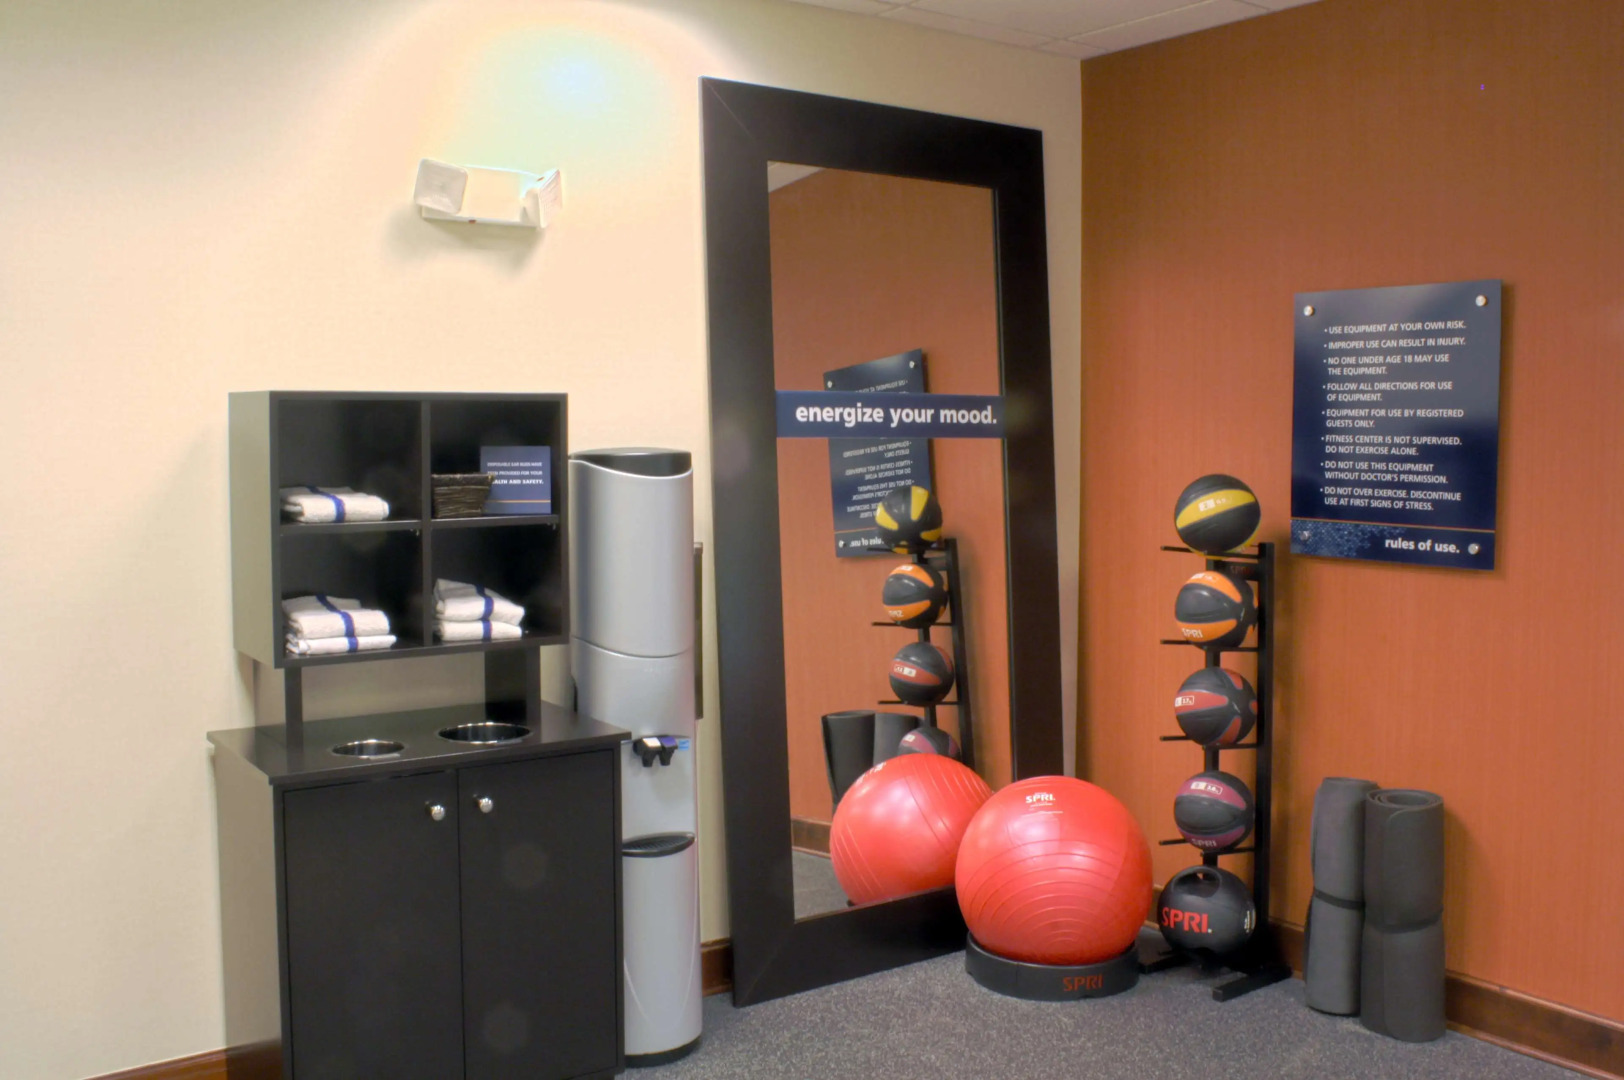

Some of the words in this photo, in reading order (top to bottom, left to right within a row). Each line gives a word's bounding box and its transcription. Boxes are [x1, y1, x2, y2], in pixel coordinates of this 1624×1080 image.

[1329, 326, 1342, 334] USE
[1344, 324, 1387, 333] EQUIPMENT
[1400, 323, 1422, 331] YOUR
[1424, 322, 1445, 330] OWN
[1447, 320, 1466, 329] RISK.
[1329, 341, 1364, 349] IMPROPER
[1366, 340, 1379, 348] USE
[1381, 340, 1397, 348] CAN
[1399, 338, 1425, 347] RESULT
[1427, 338, 1435, 346] IN
[1437, 337, 1466, 346] INJURY.
[1358, 356, 1384, 364] UNDER
[1404, 355, 1412, 363] 18
[1414, 355, 1433, 363] MAY
[1435, 354, 1449, 362] USE
[1344, 367, 1388, 375] EQUIPMENT.
[1374, 382, 1418, 390] DIRECTIONS
[1420, 382, 1436, 390] FOR
[1338, 394, 1382, 402] EQUIPMENT.
[796, 402, 884, 427] energize
[889, 407, 935, 428] your
[940, 405, 997, 424] mood.
[1326, 409, 1369, 418] EQUIPMENT
[1371, 409, 1386, 417] FOR
[1388, 409, 1402, 417] USE
[1404, 409, 1415, 417] BY
[1417, 409, 1463, 417] REGISTERED
[1326, 435, 1353, 443] FITNESS
[1355, 436, 1383, 444] CENTER
[1385, 436, 1392, 444] IS
[1394, 436, 1410, 444] NOT
[1412, 437, 1462, 445] SUPERVISED.
[1338, 446, 1354, 454] NOT
[1356, 446, 1388, 455] EXERCISE
[1391, 447, 1419, 455] ALONE.
[1338, 461, 1353, 469] NOT
[1355, 462, 1369, 470] USE
[1371, 462, 1387, 470] THIS
[1389, 463, 1434, 472] EQUIPMENT
[1325, 472, 1359, 480] WITHOUT
[1361, 472, 1398, 482] DOCTOR'S
[1400, 474, 1448, 483] PERMISSION.
[1337, 487, 1352, 495] NOT
[1353, 488, 1373, 496] OVER
[1374, 489, 1409, 498] EXERCISE.
[1410, 490, 1461, 500] DISCONTINUE
[1339, 498, 1348, 506] AT
[1350, 498, 1369, 507] FIRST
[1371, 500, 1391, 508] SIGNS
[1393, 500, 1404, 509] OF
[1405, 501, 1434, 510] STRESS.
[1385, 538, 1414, 549] rules
[1418, 539, 1431, 551] of
[1435, 542, 1460, 553] use.
[1063, 974, 1103, 992] SPRI
